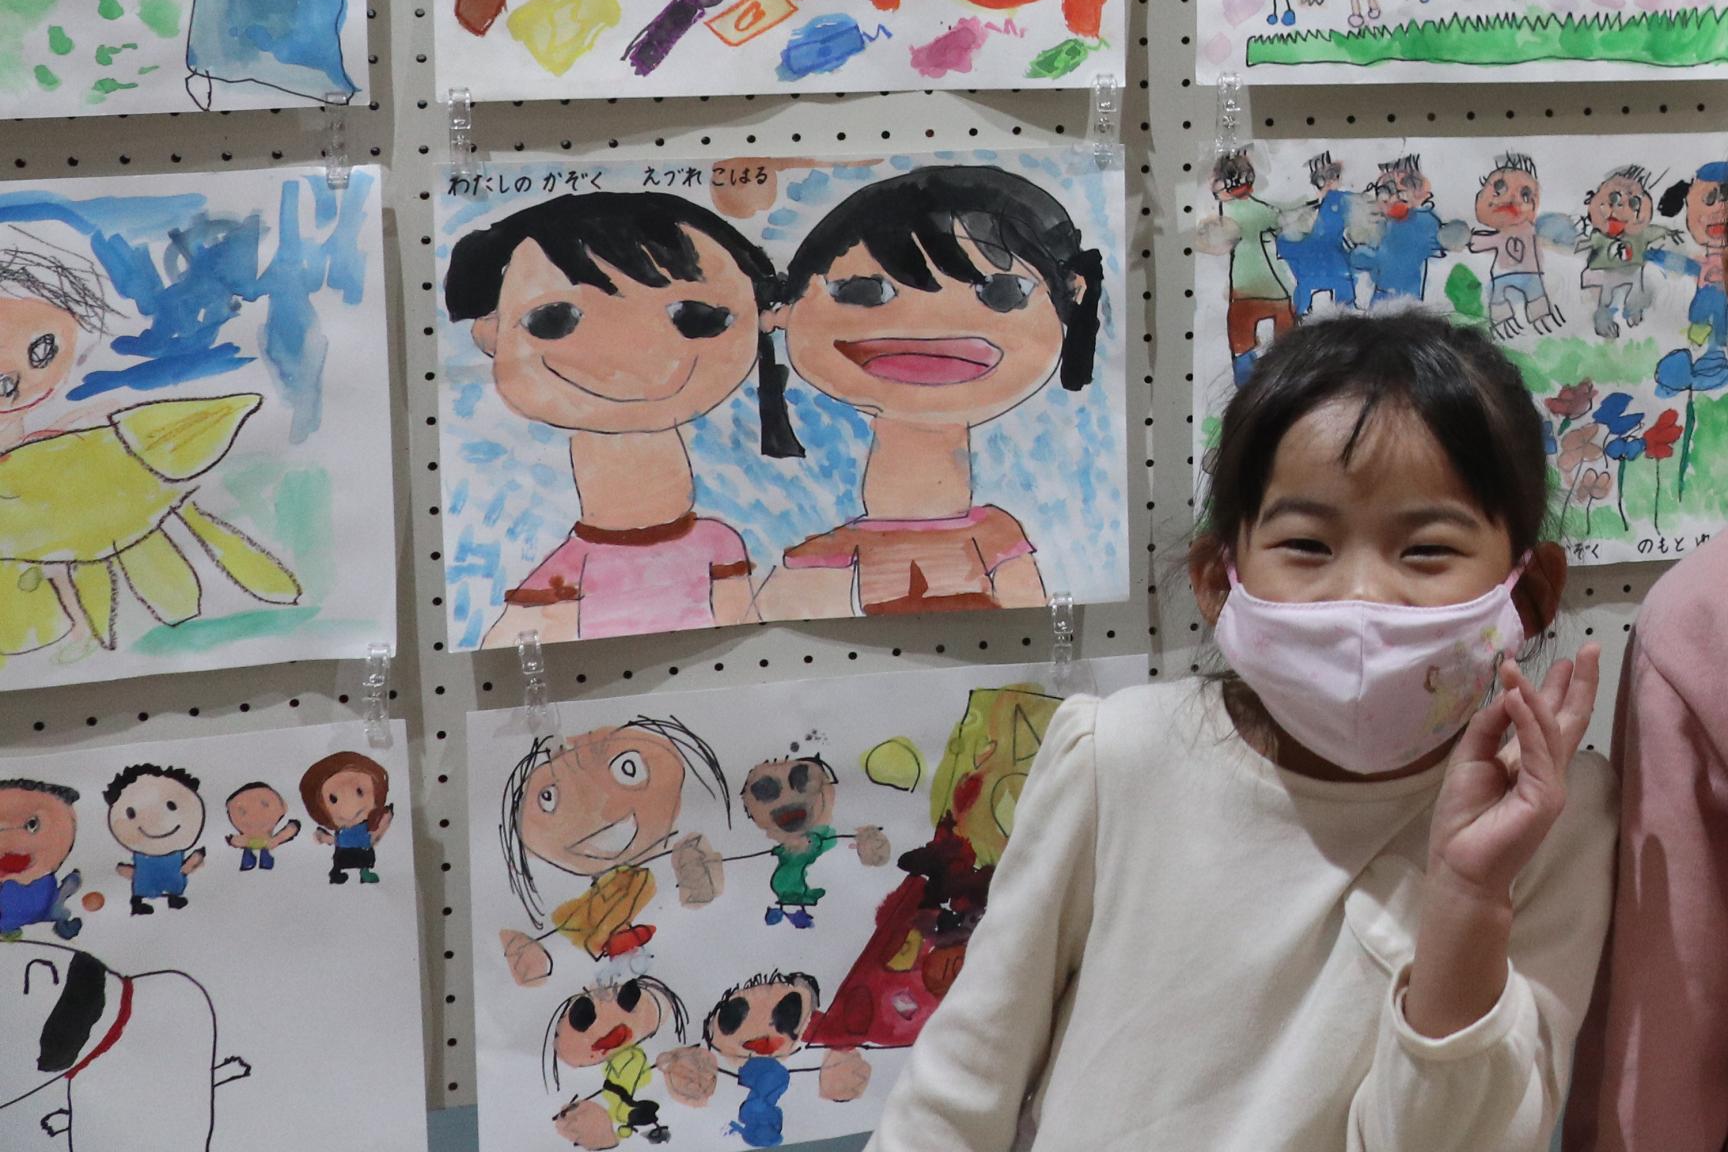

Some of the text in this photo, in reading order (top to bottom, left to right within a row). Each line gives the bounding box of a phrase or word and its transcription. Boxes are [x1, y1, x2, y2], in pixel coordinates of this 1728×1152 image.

[447, 173, 532, 196] わたしの
[543, 170, 602, 192] かぞく
[712, 166, 768, 186] こはる
